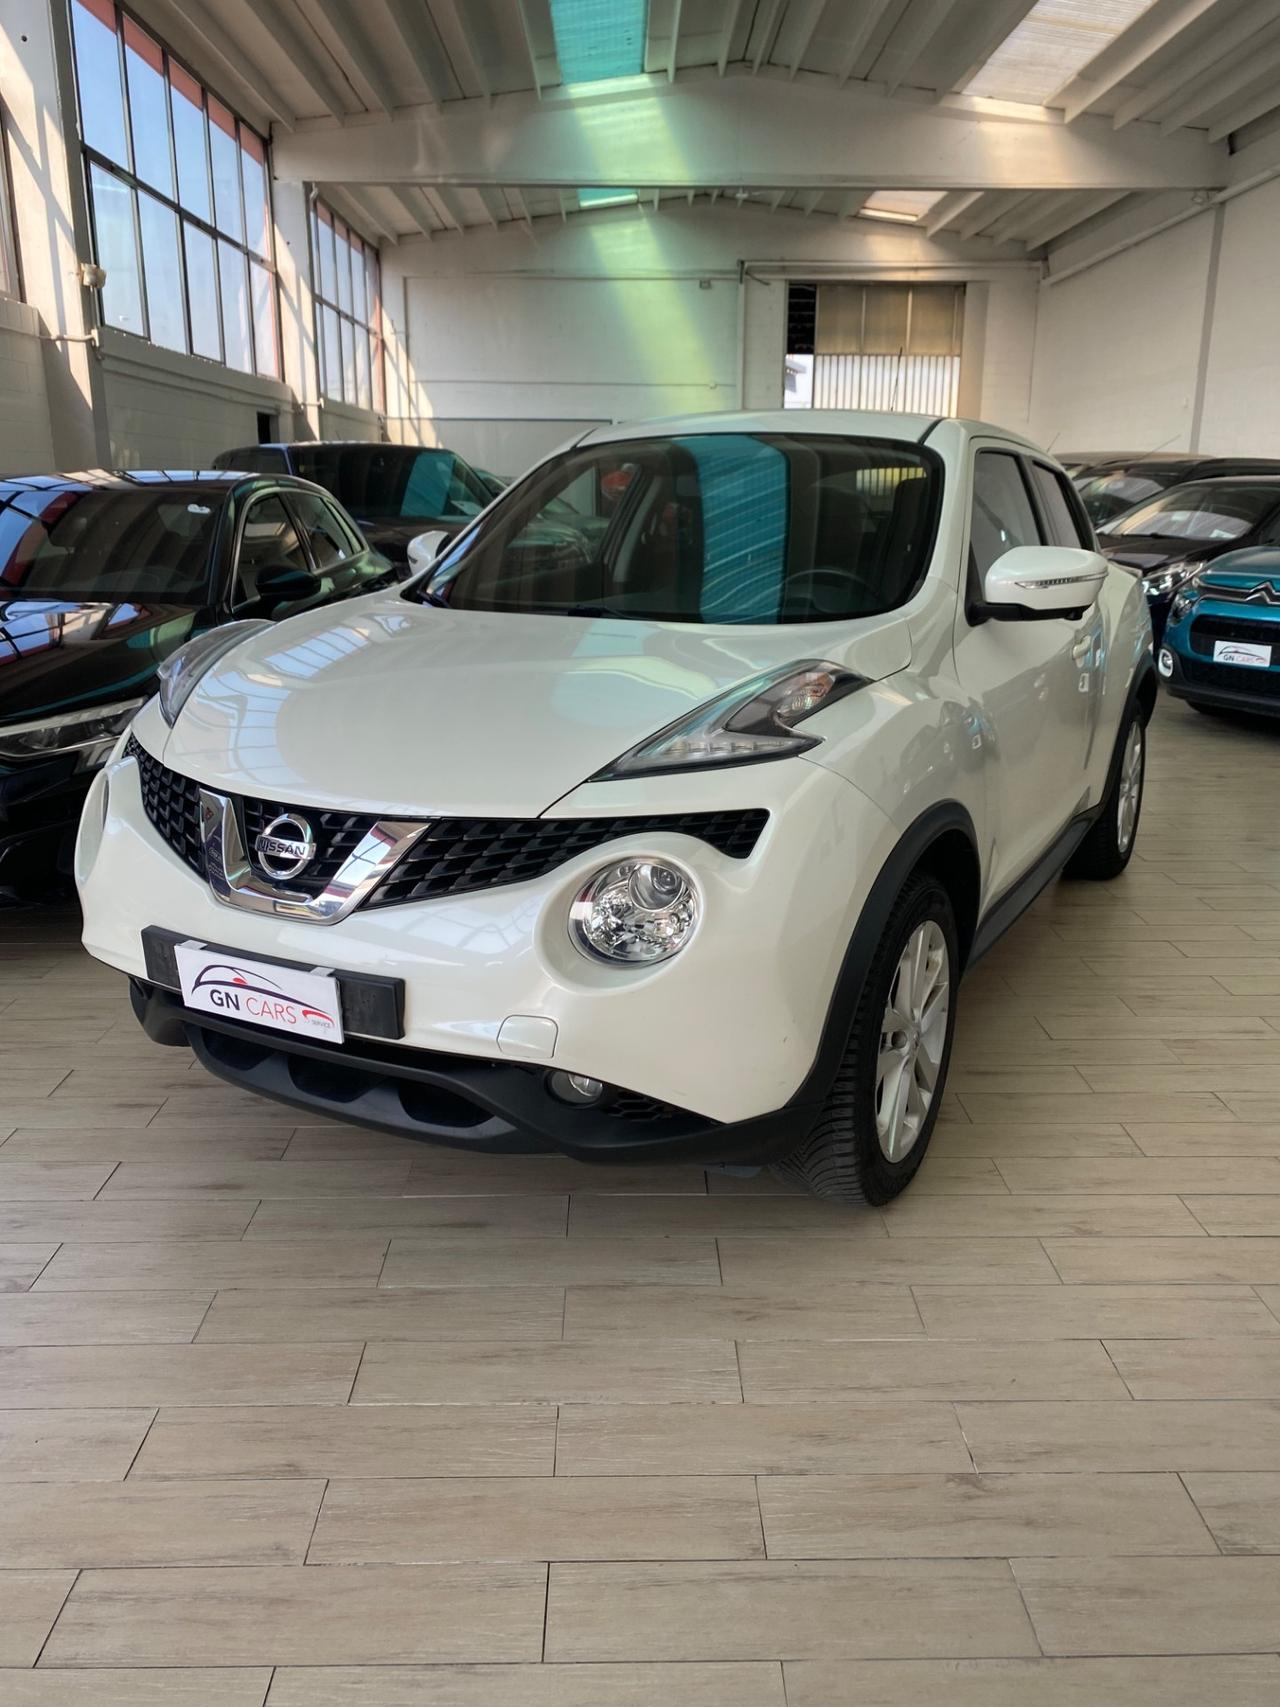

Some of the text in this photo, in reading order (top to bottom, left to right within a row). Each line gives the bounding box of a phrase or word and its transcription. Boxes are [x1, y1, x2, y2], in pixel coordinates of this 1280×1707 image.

[257, 837, 306, 856] NISSAN
[209, 988, 241, 1011] GN
[246, 996, 297, 1024] CARS
